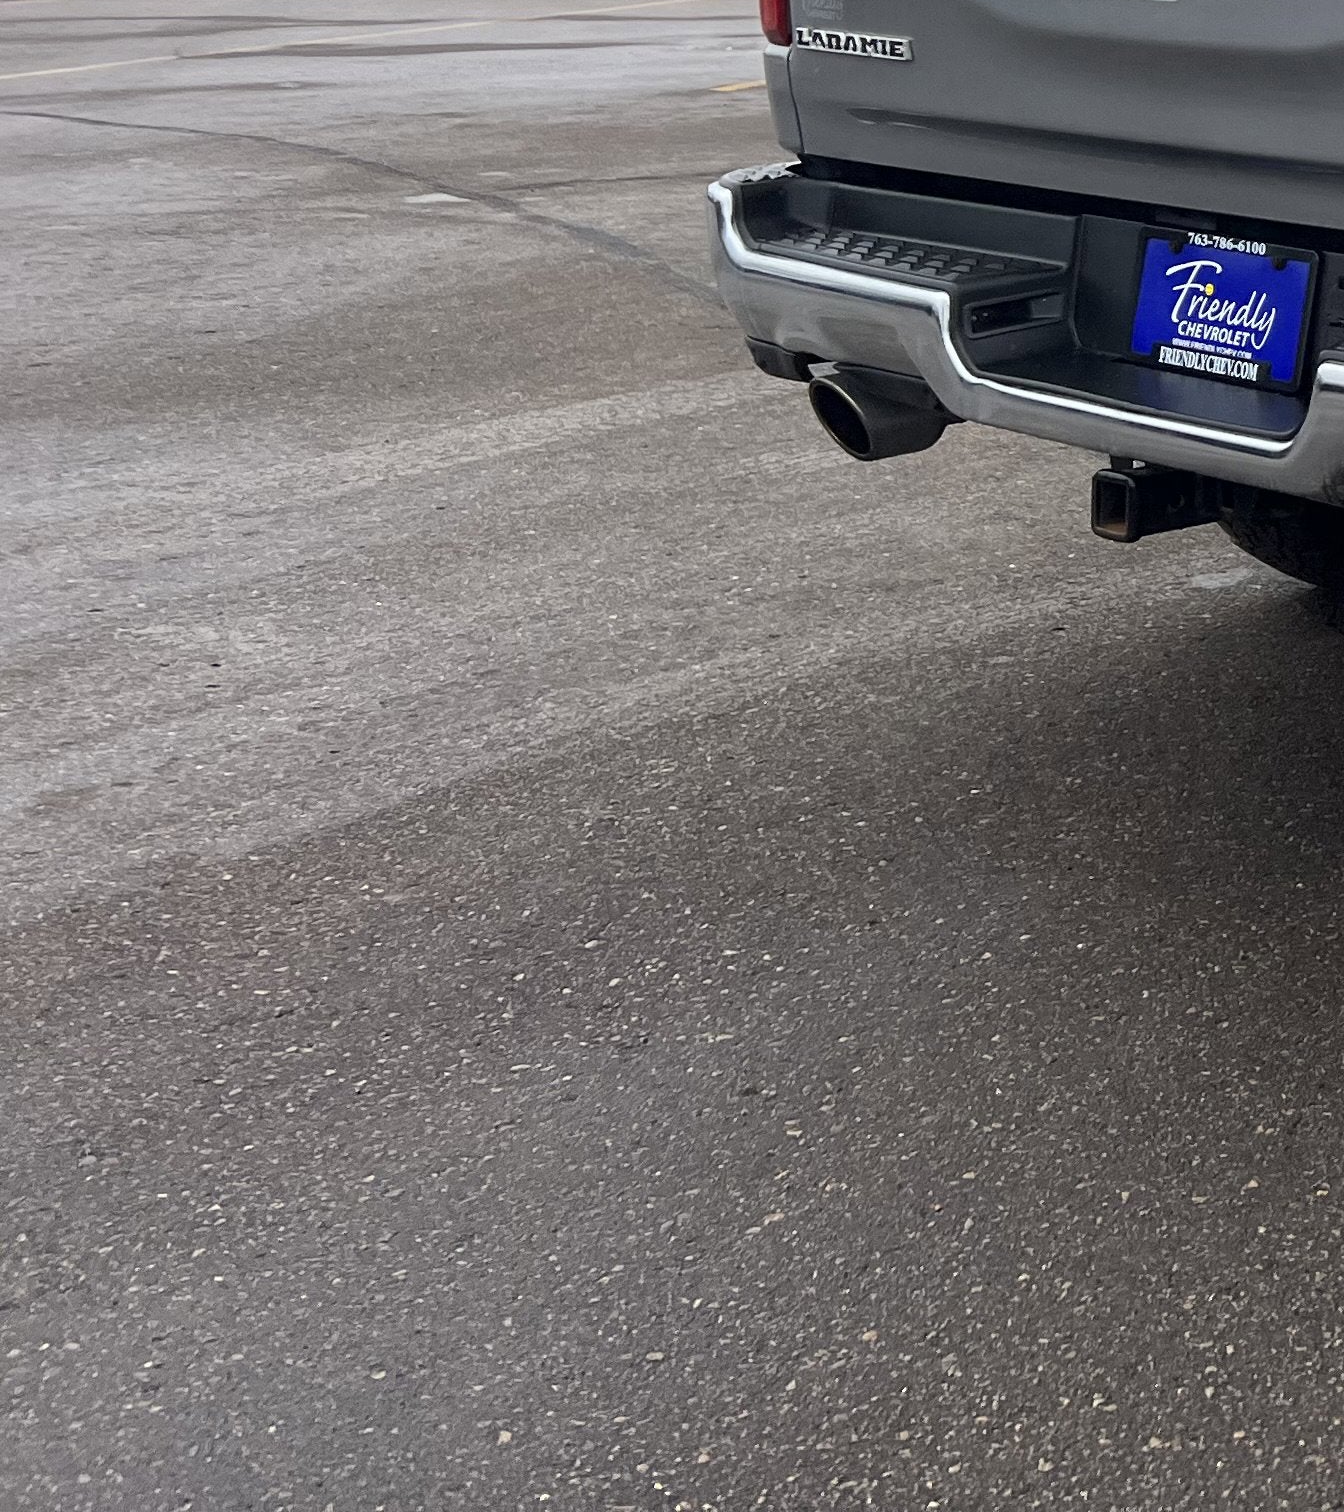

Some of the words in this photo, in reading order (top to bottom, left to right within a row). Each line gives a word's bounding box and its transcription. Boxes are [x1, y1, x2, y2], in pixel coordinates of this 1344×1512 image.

[1188, 232, 1266, 255] 763-786-6100
[1165, 260, 1276, 350] Friendly
[1178, 320, 1250, 347] CHEVROLET
[1159, 346, 1259, 381] FRIENDLYCHEV.COM
